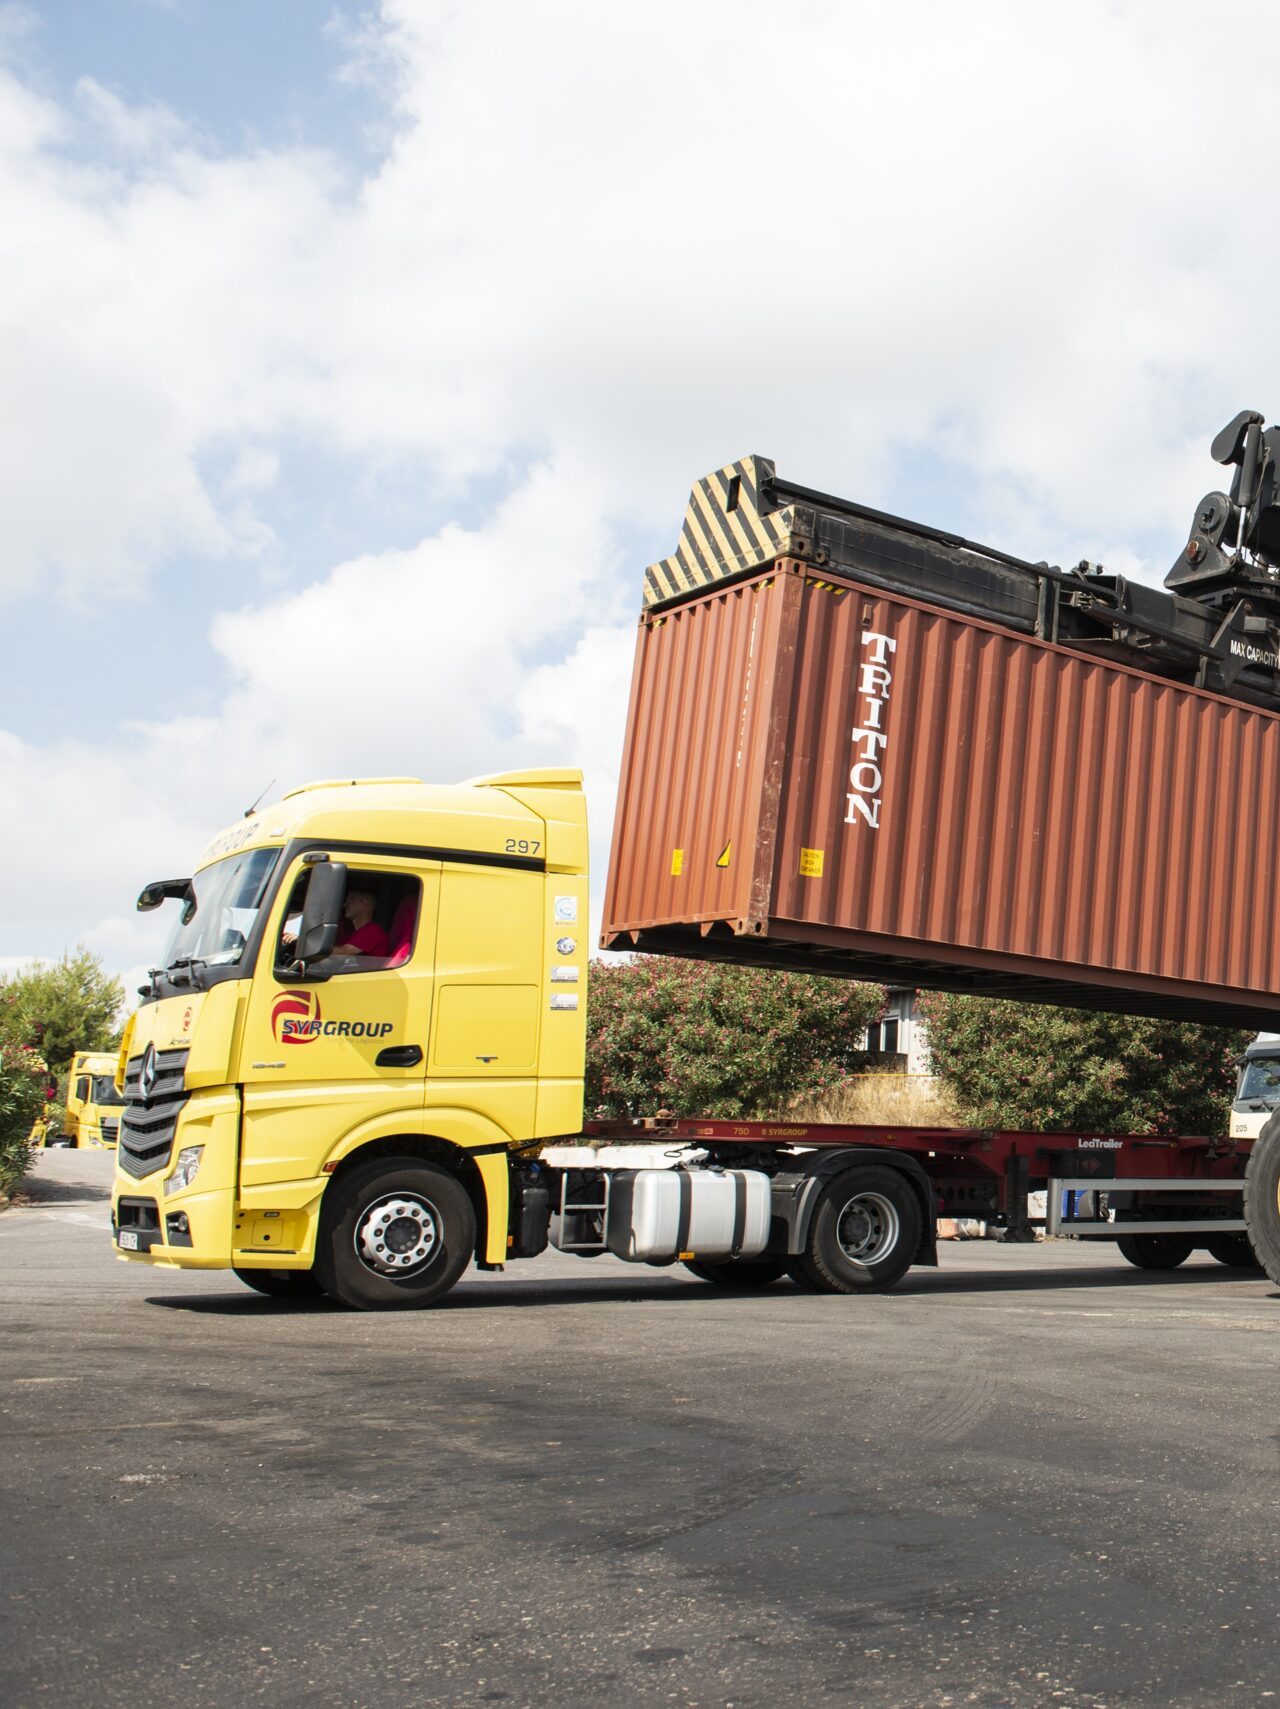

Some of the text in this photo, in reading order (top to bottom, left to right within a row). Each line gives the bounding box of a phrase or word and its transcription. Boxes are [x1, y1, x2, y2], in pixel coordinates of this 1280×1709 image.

[1230, 639, 1246, 658] MAX
[1246, 645, 1279, 668] CAPACITY
[843, 630, 897, 829] TRITON
[505, 838, 541, 855] 297
[282, 1019, 393, 1038] SYRGROUP
[733, 1127, 808, 1136] 750 SYRGROUP
[1235, 1124, 1248, 1133] 205
